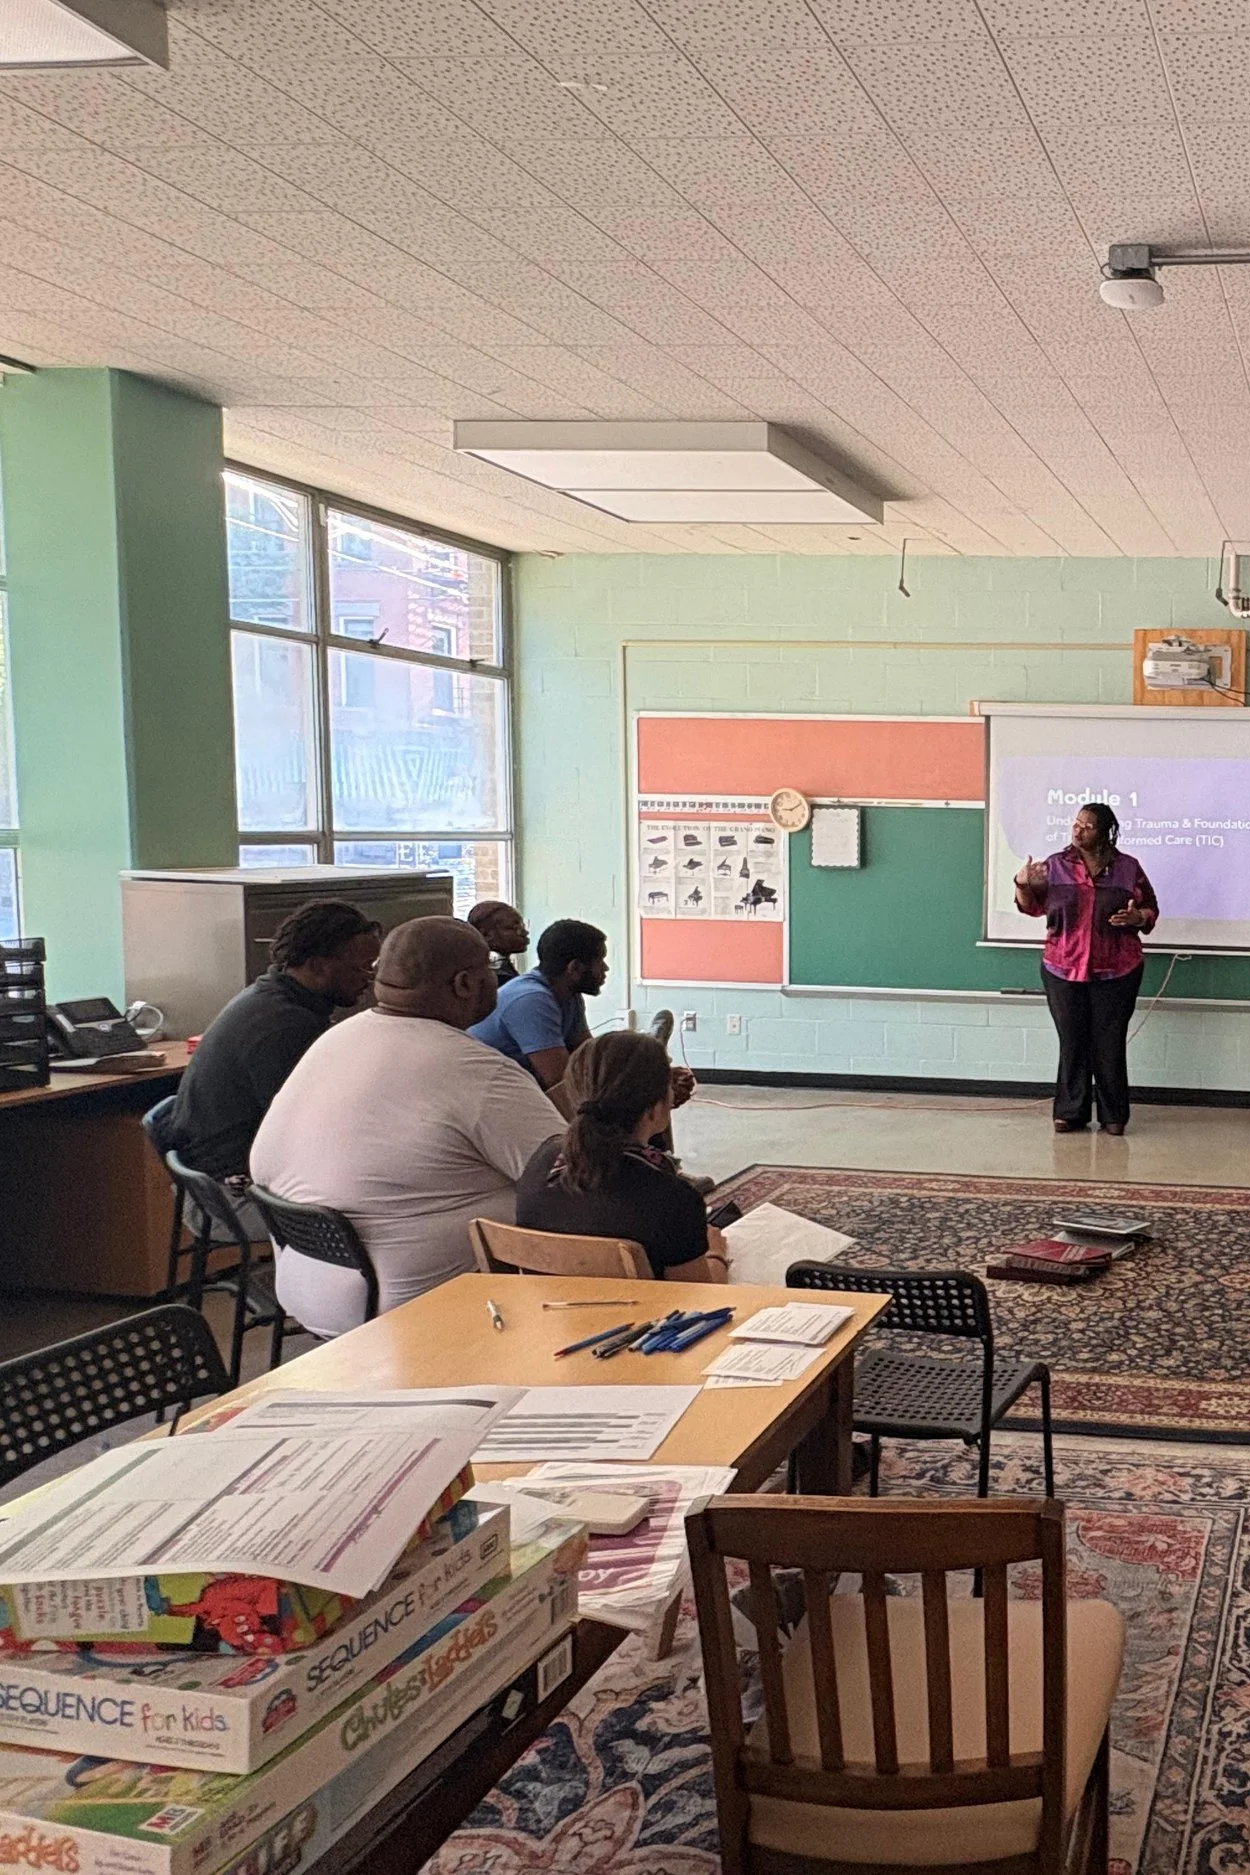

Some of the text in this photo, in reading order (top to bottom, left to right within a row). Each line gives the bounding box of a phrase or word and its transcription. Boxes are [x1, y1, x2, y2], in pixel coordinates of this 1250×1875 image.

[1047, 788, 1138, 807] Module 1
[1135, 818, 1179, 829] Trauma
[1182, 819, 1192, 829] &
[1046, 831, 1059, 842] of
[1165, 835, 1192, 846] Care
[1195, 835, 1224, 847] (TIC)
[306, 1592, 415, 1692] SEQUENCE
[140, 1703, 177, 1733] for
[181, 1703, 228, 1732] kids
